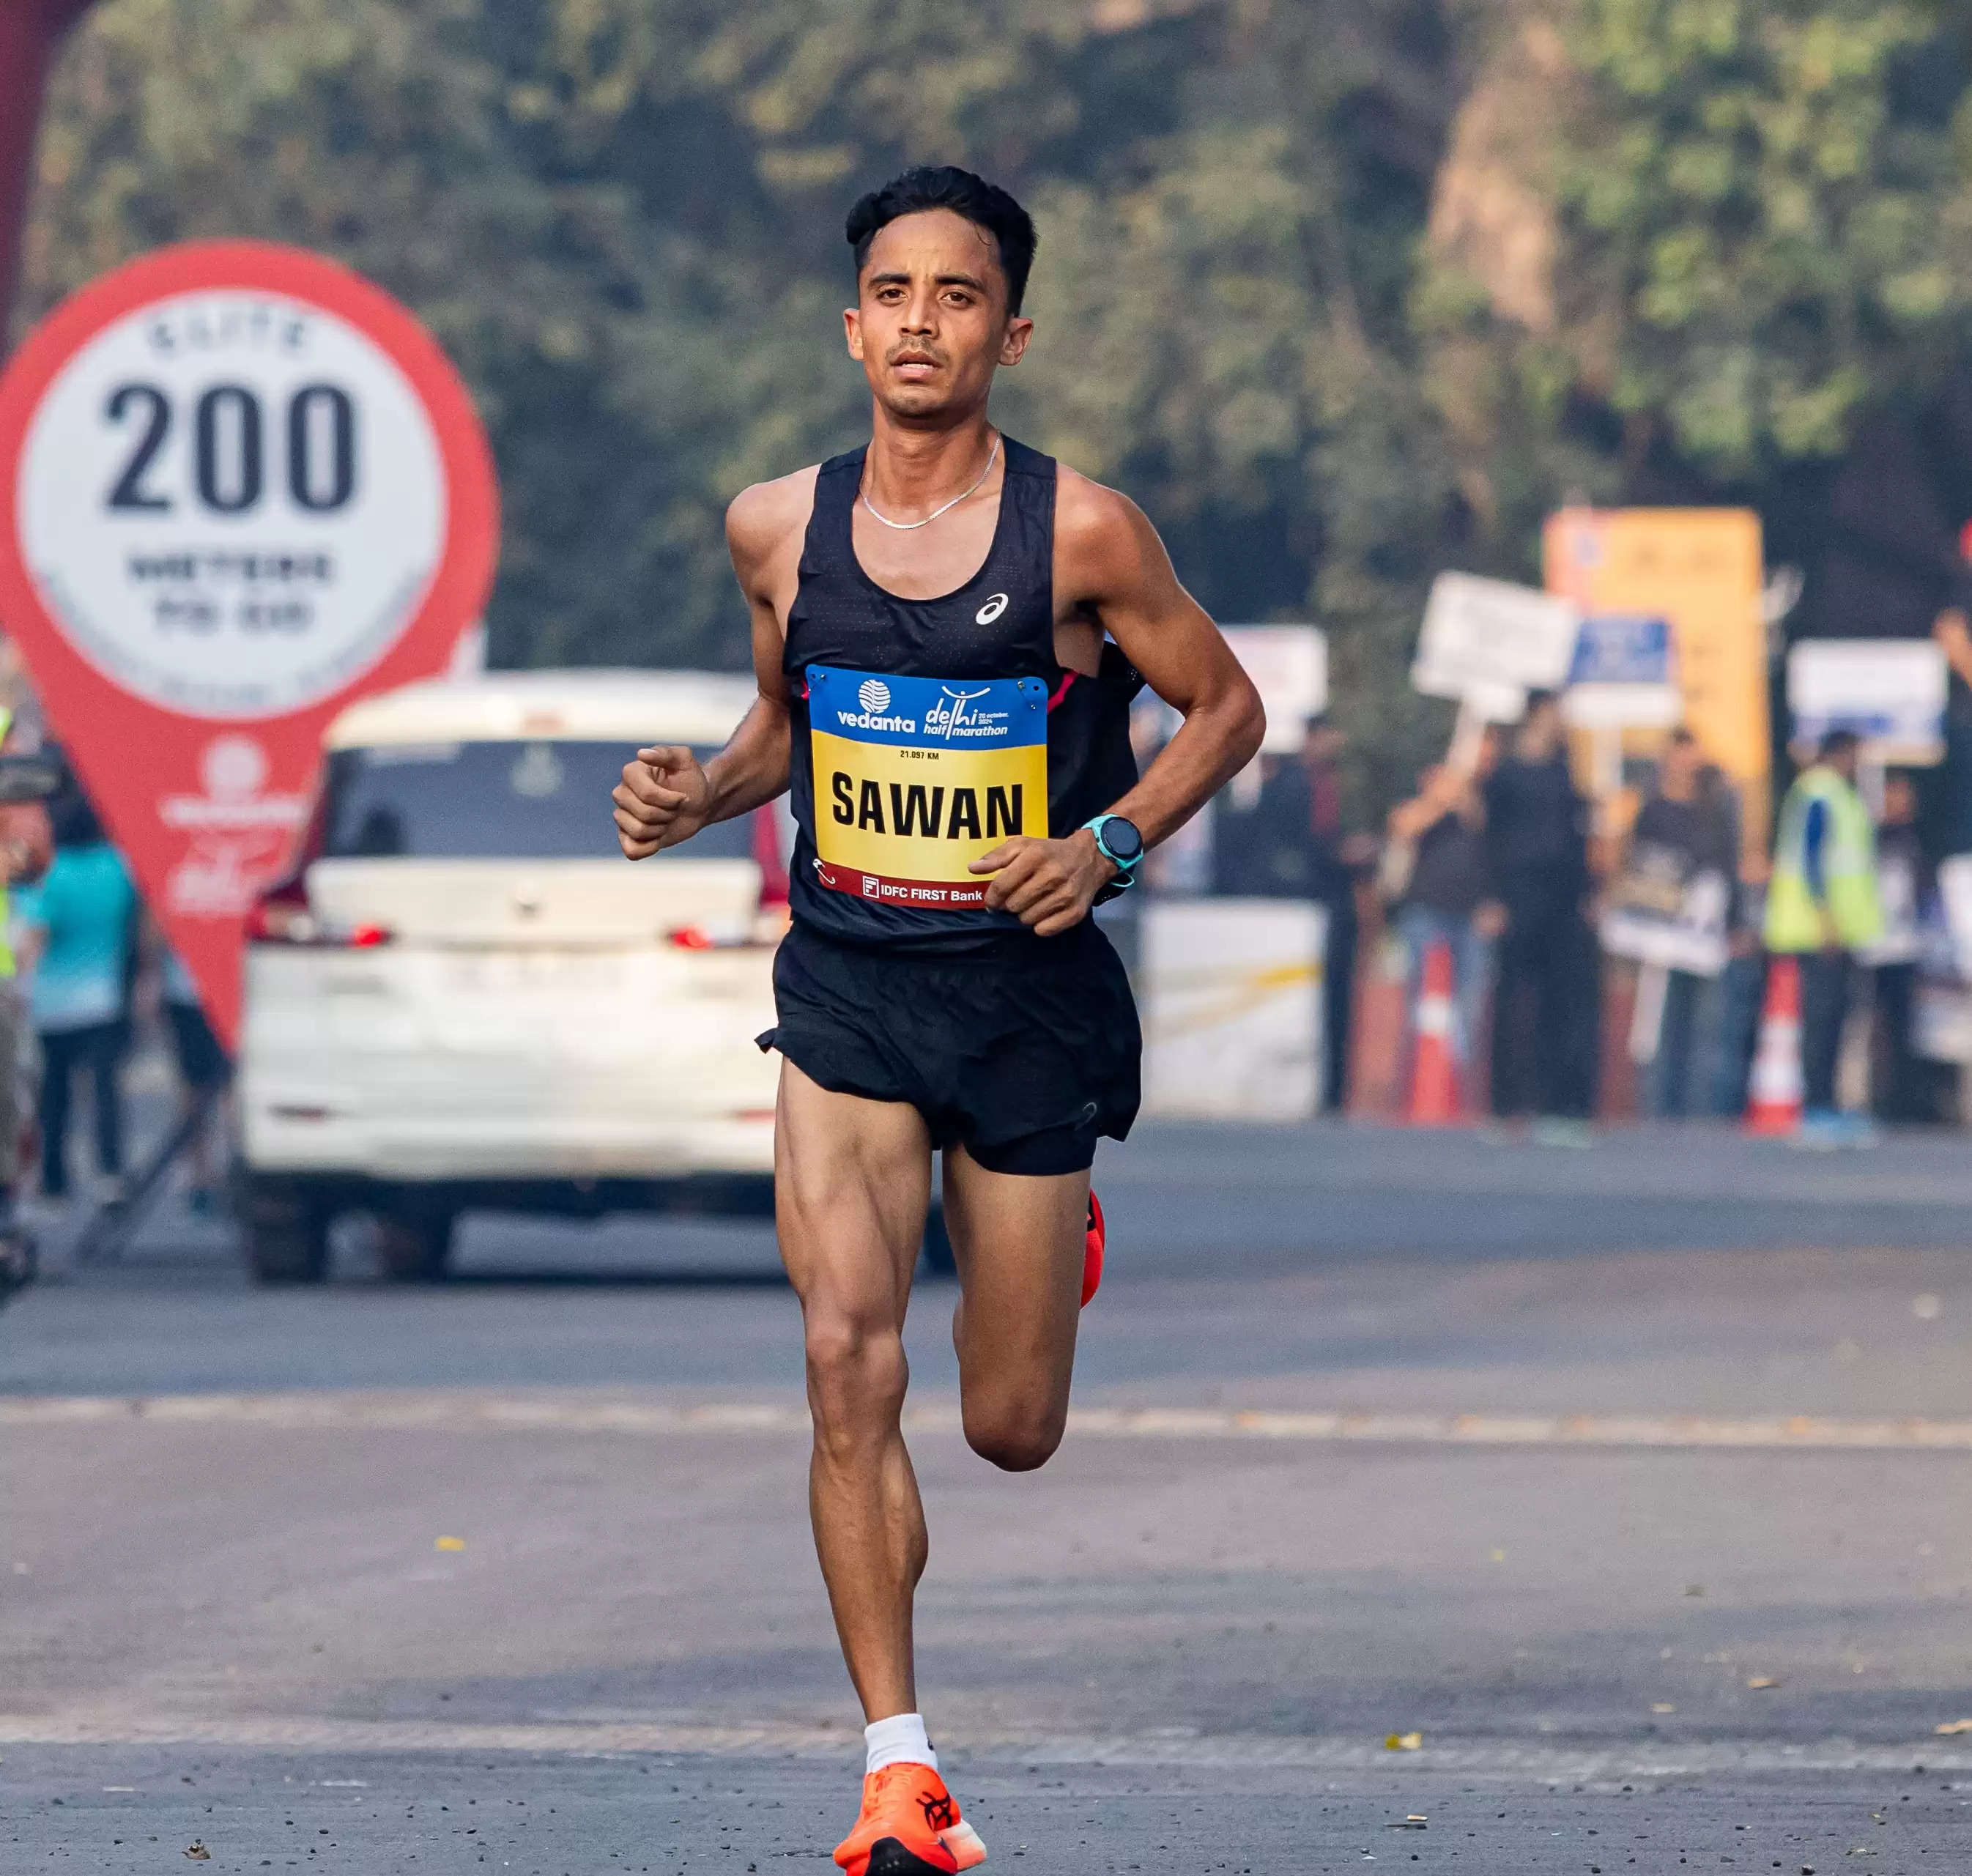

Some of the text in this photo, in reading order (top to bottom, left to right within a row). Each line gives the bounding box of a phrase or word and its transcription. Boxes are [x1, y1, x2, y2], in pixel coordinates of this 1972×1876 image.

[106, 384, 356, 511] 200
[837, 711, 916, 733] vedanta
[924, 697, 979, 740] delhi
[923, 723, 1008, 737] half marathon
[900, 750, 924, 759] 21.097
[831, 771, 1023, 839] SAWAN
[881, 884, 983, 902] IDFC FIRST Bank
